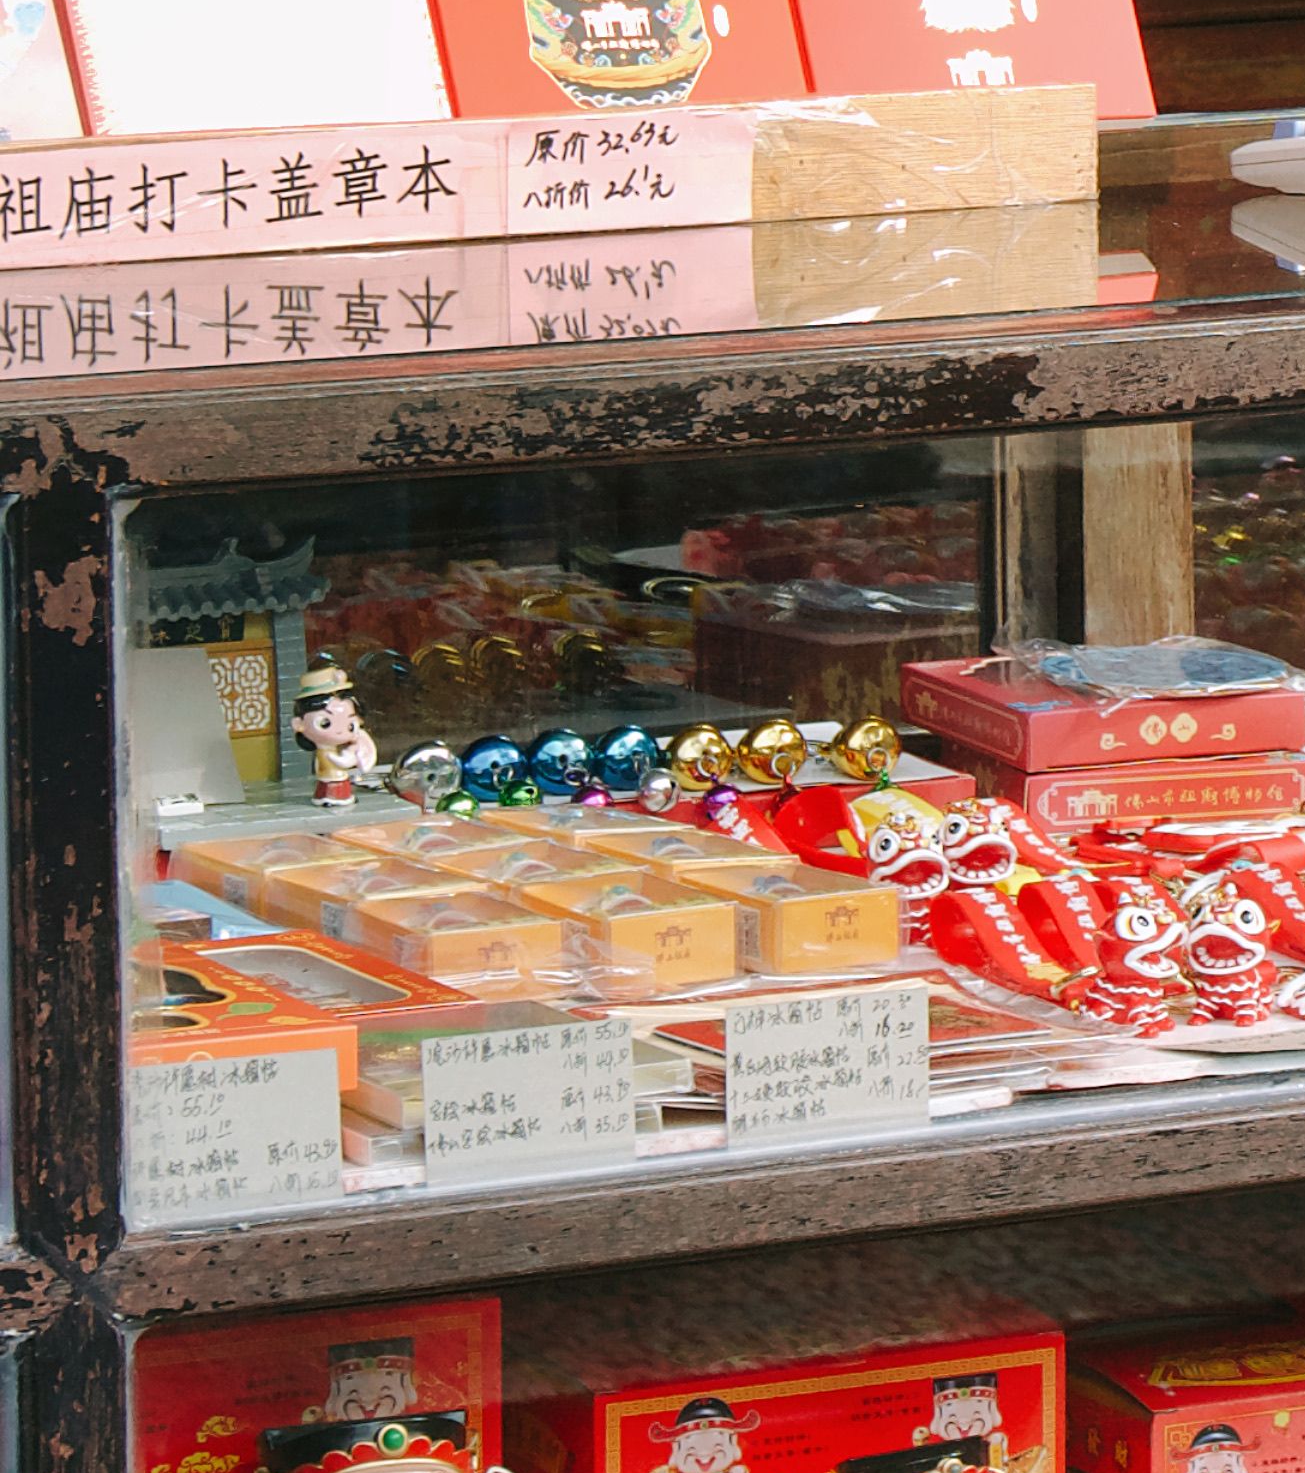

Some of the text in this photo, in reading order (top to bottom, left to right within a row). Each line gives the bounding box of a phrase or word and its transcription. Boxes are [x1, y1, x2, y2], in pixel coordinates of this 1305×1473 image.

[525, 129, 590, 168] 原价
[0, 144, 459, 242] 祖庙打卡盖章本
[523, 179, 591, 210] 八折价
